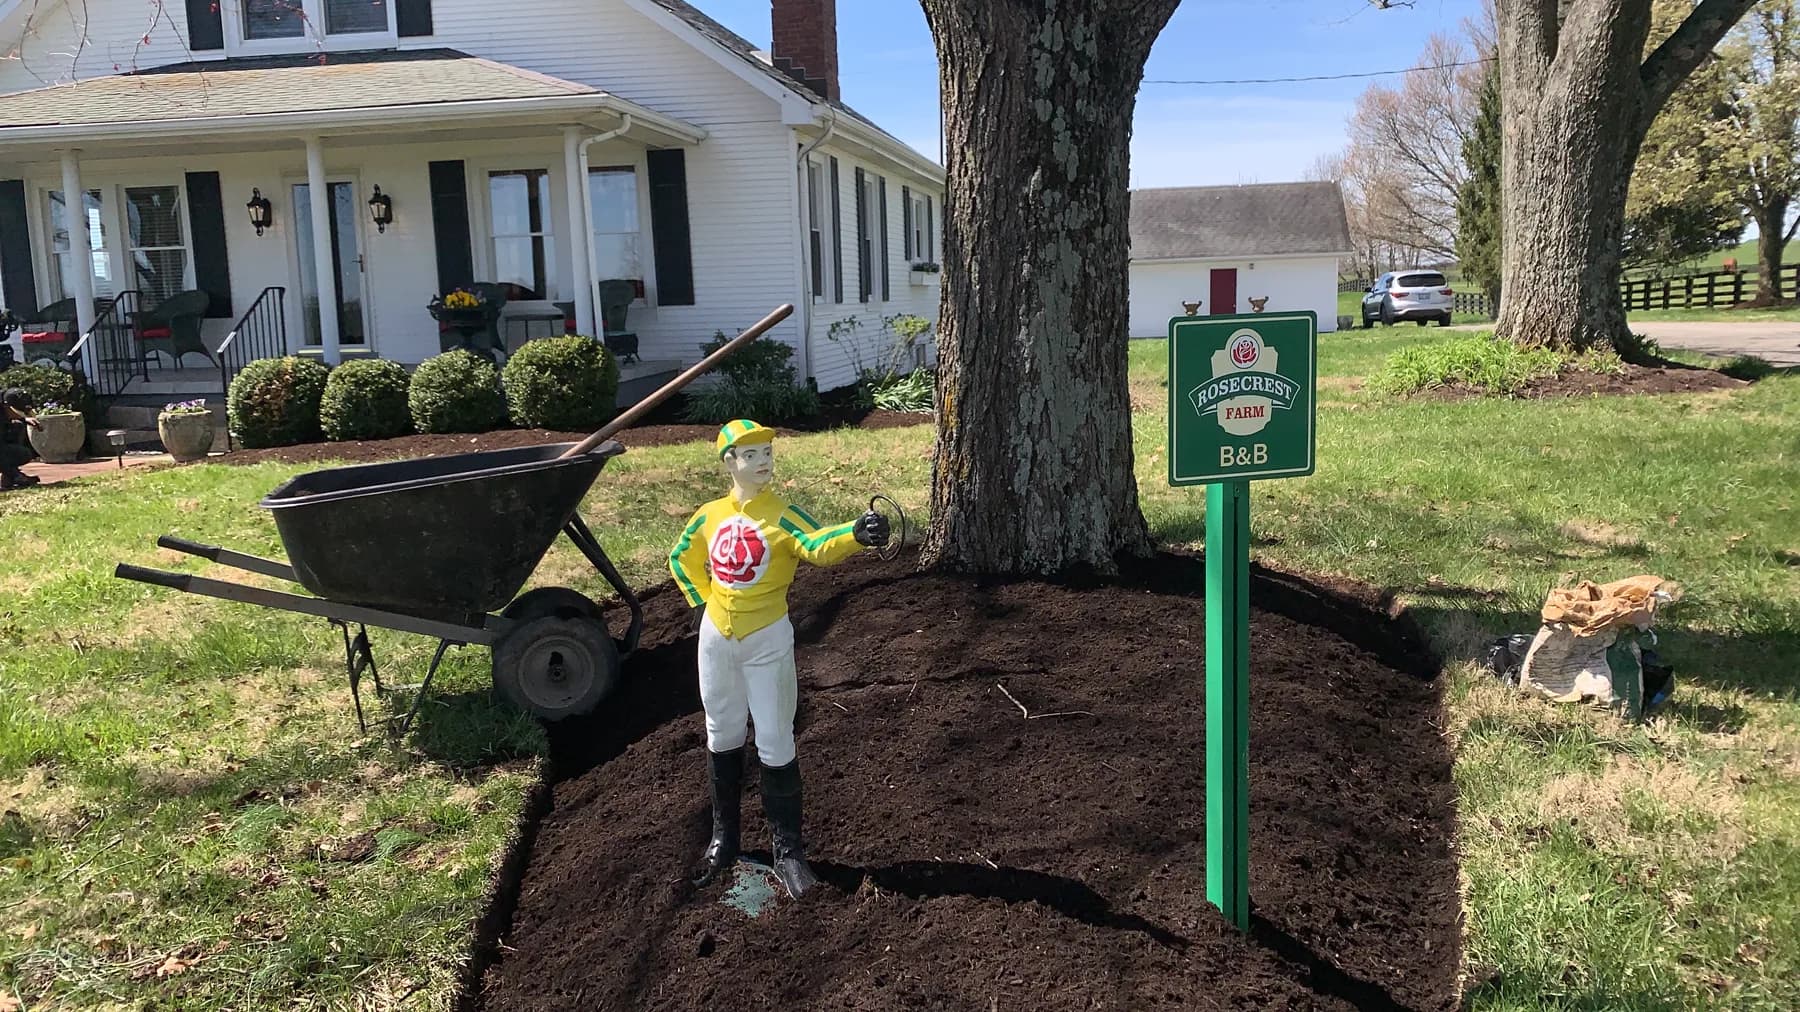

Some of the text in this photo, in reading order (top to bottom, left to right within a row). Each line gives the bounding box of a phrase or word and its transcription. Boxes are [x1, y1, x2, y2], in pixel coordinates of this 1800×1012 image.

[1197, 375, 1292, 408] ROSECREST
[1225, 405, 1265, 420] FARM
[1220, 443, 1268, 467] B&B
